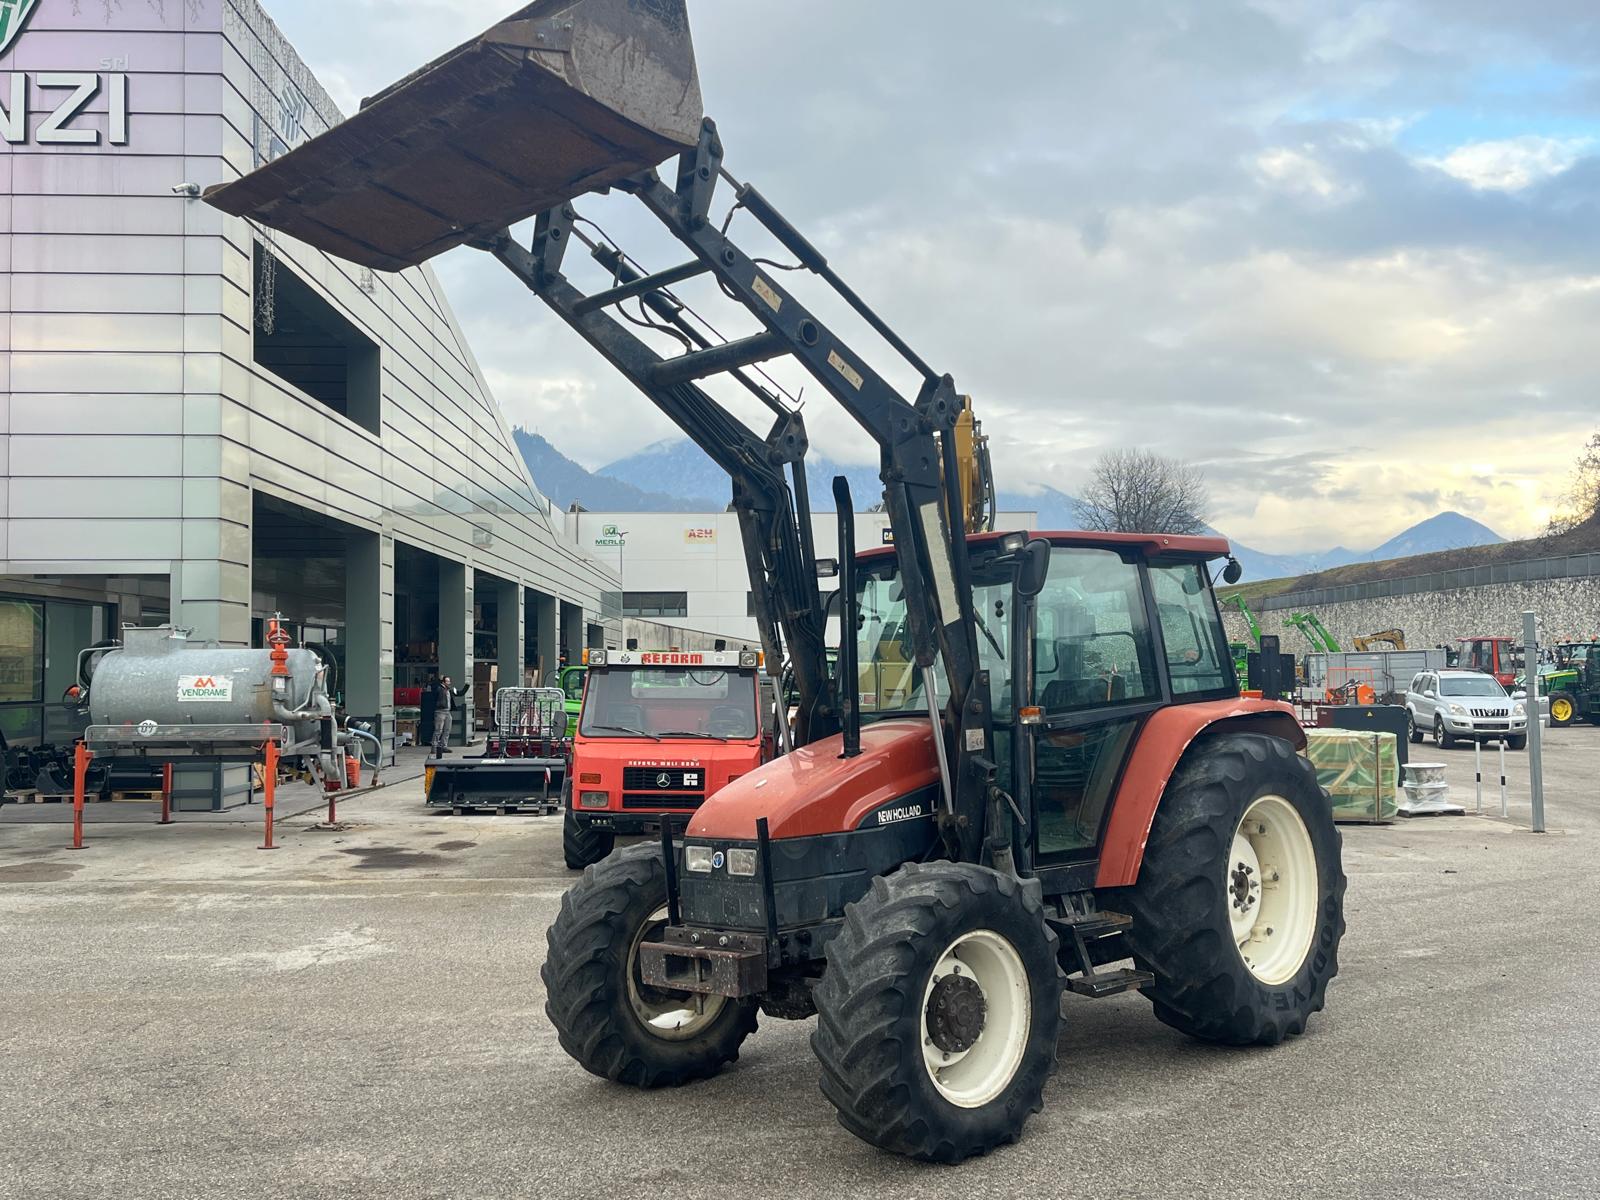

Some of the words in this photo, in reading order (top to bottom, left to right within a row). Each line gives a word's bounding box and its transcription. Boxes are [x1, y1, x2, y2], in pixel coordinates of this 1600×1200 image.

[100, 54, 129, 70] srl
[641, 652, 704, 664] REFORM
[181, 688, 228, 697] VENDRAME
